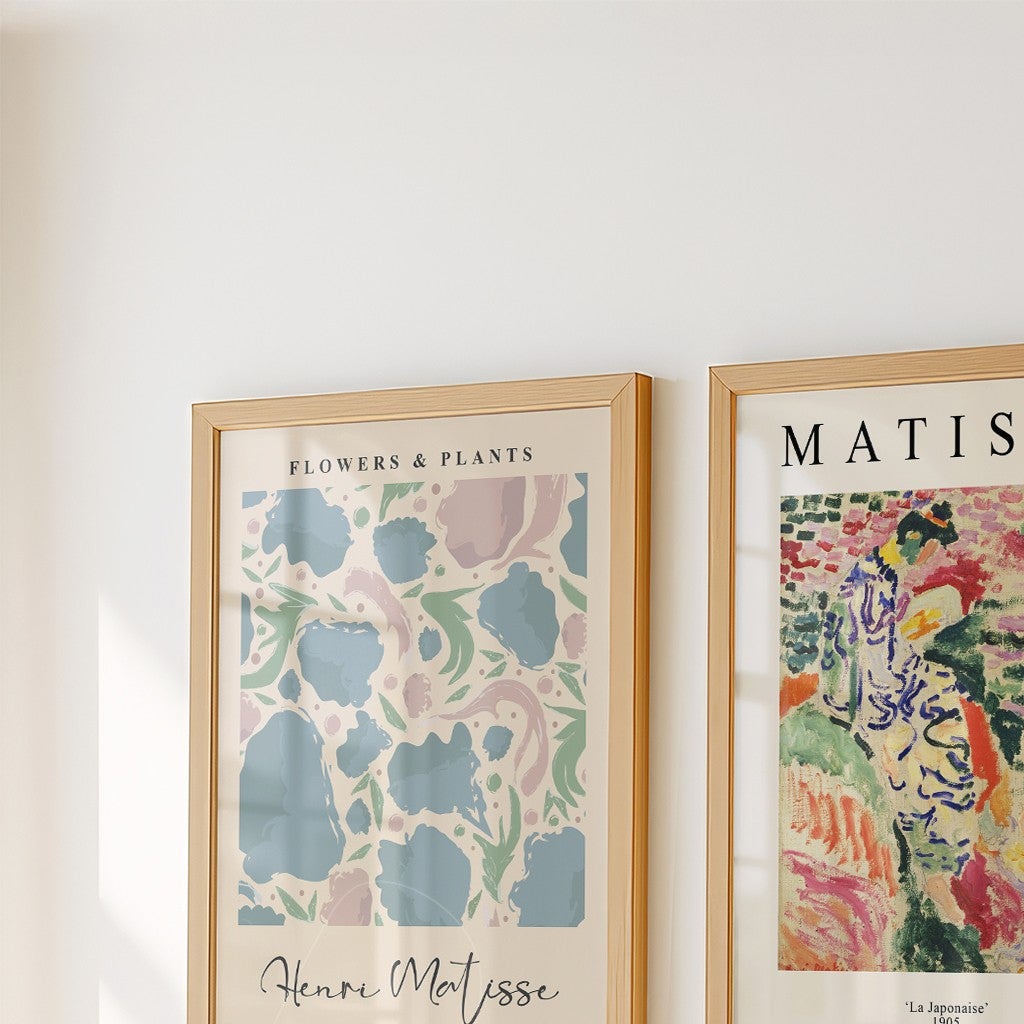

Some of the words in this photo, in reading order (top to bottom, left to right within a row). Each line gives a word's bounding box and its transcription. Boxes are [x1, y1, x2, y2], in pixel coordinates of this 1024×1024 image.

[289, 453, 401, 476] FLOWERS
[412, 452, 428, 469] &
[440, 446, 534, 468] PLANTS
[260, 955, 381, 1008] Henri
